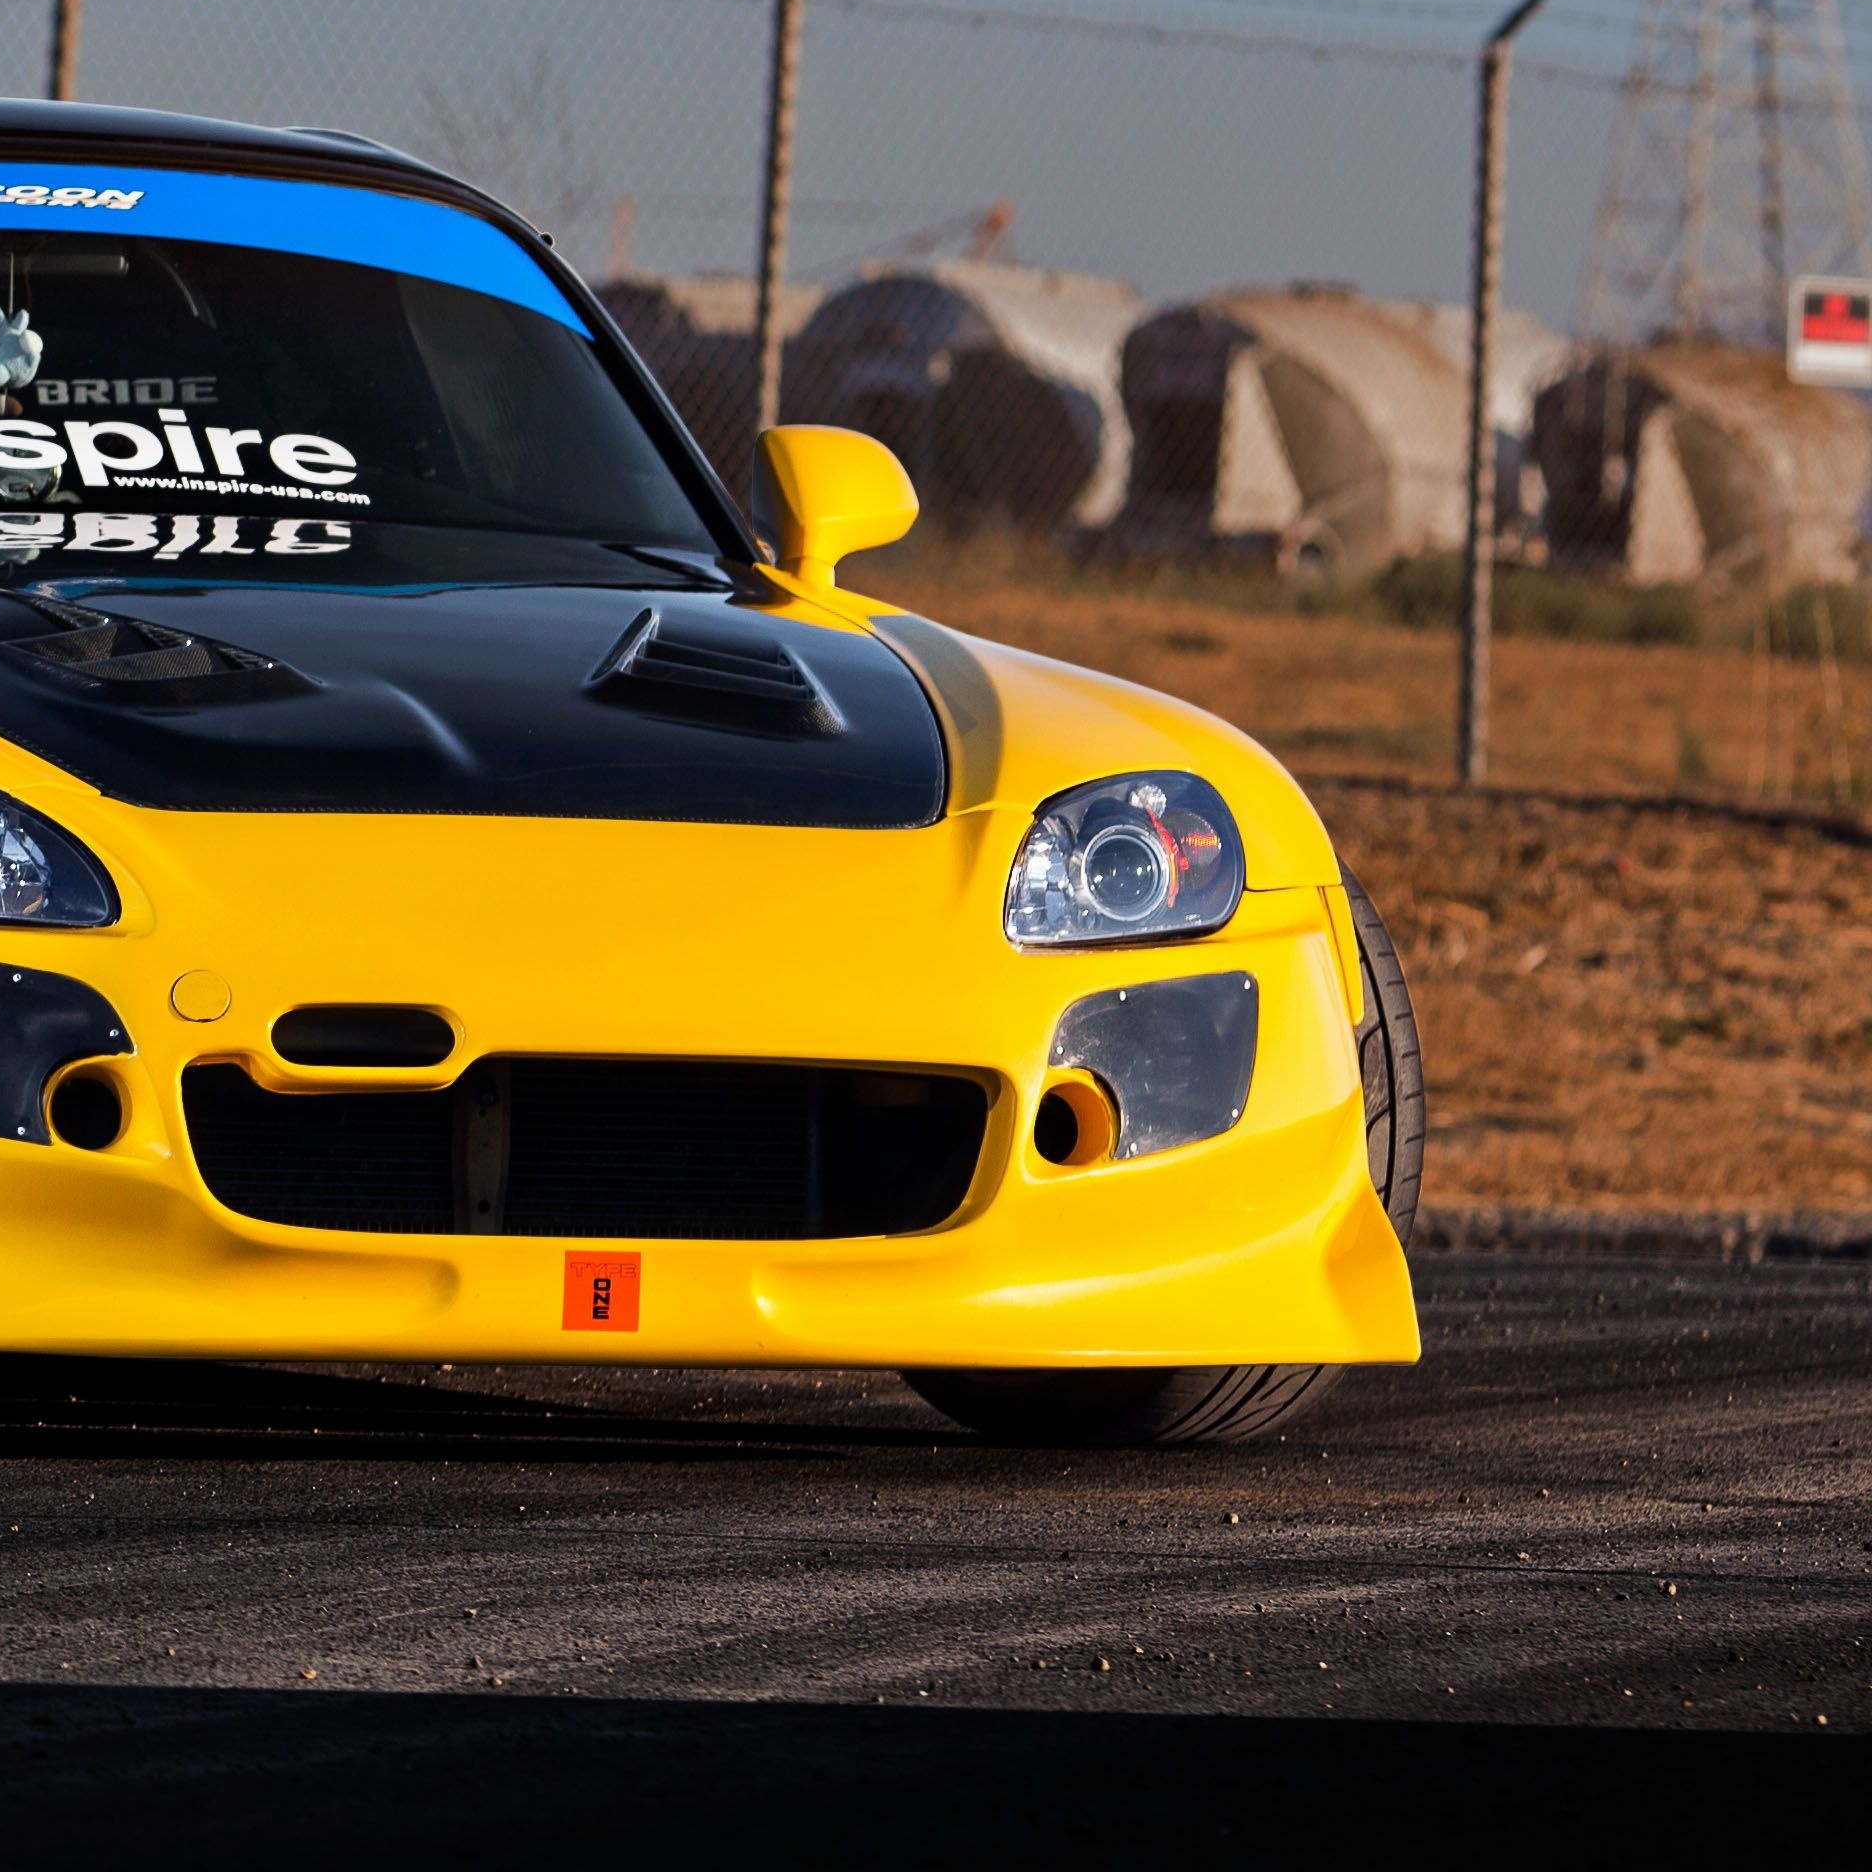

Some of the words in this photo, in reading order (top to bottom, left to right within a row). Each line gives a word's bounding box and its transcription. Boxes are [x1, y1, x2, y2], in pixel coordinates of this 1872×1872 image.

[34, 376, 219, 406] BRIDE
[113, 475, 371, 506] www.inspire-usa.com
[570, 1262, 637, 1279] TYPE
[592, 1277, 611, 1320] ONE
